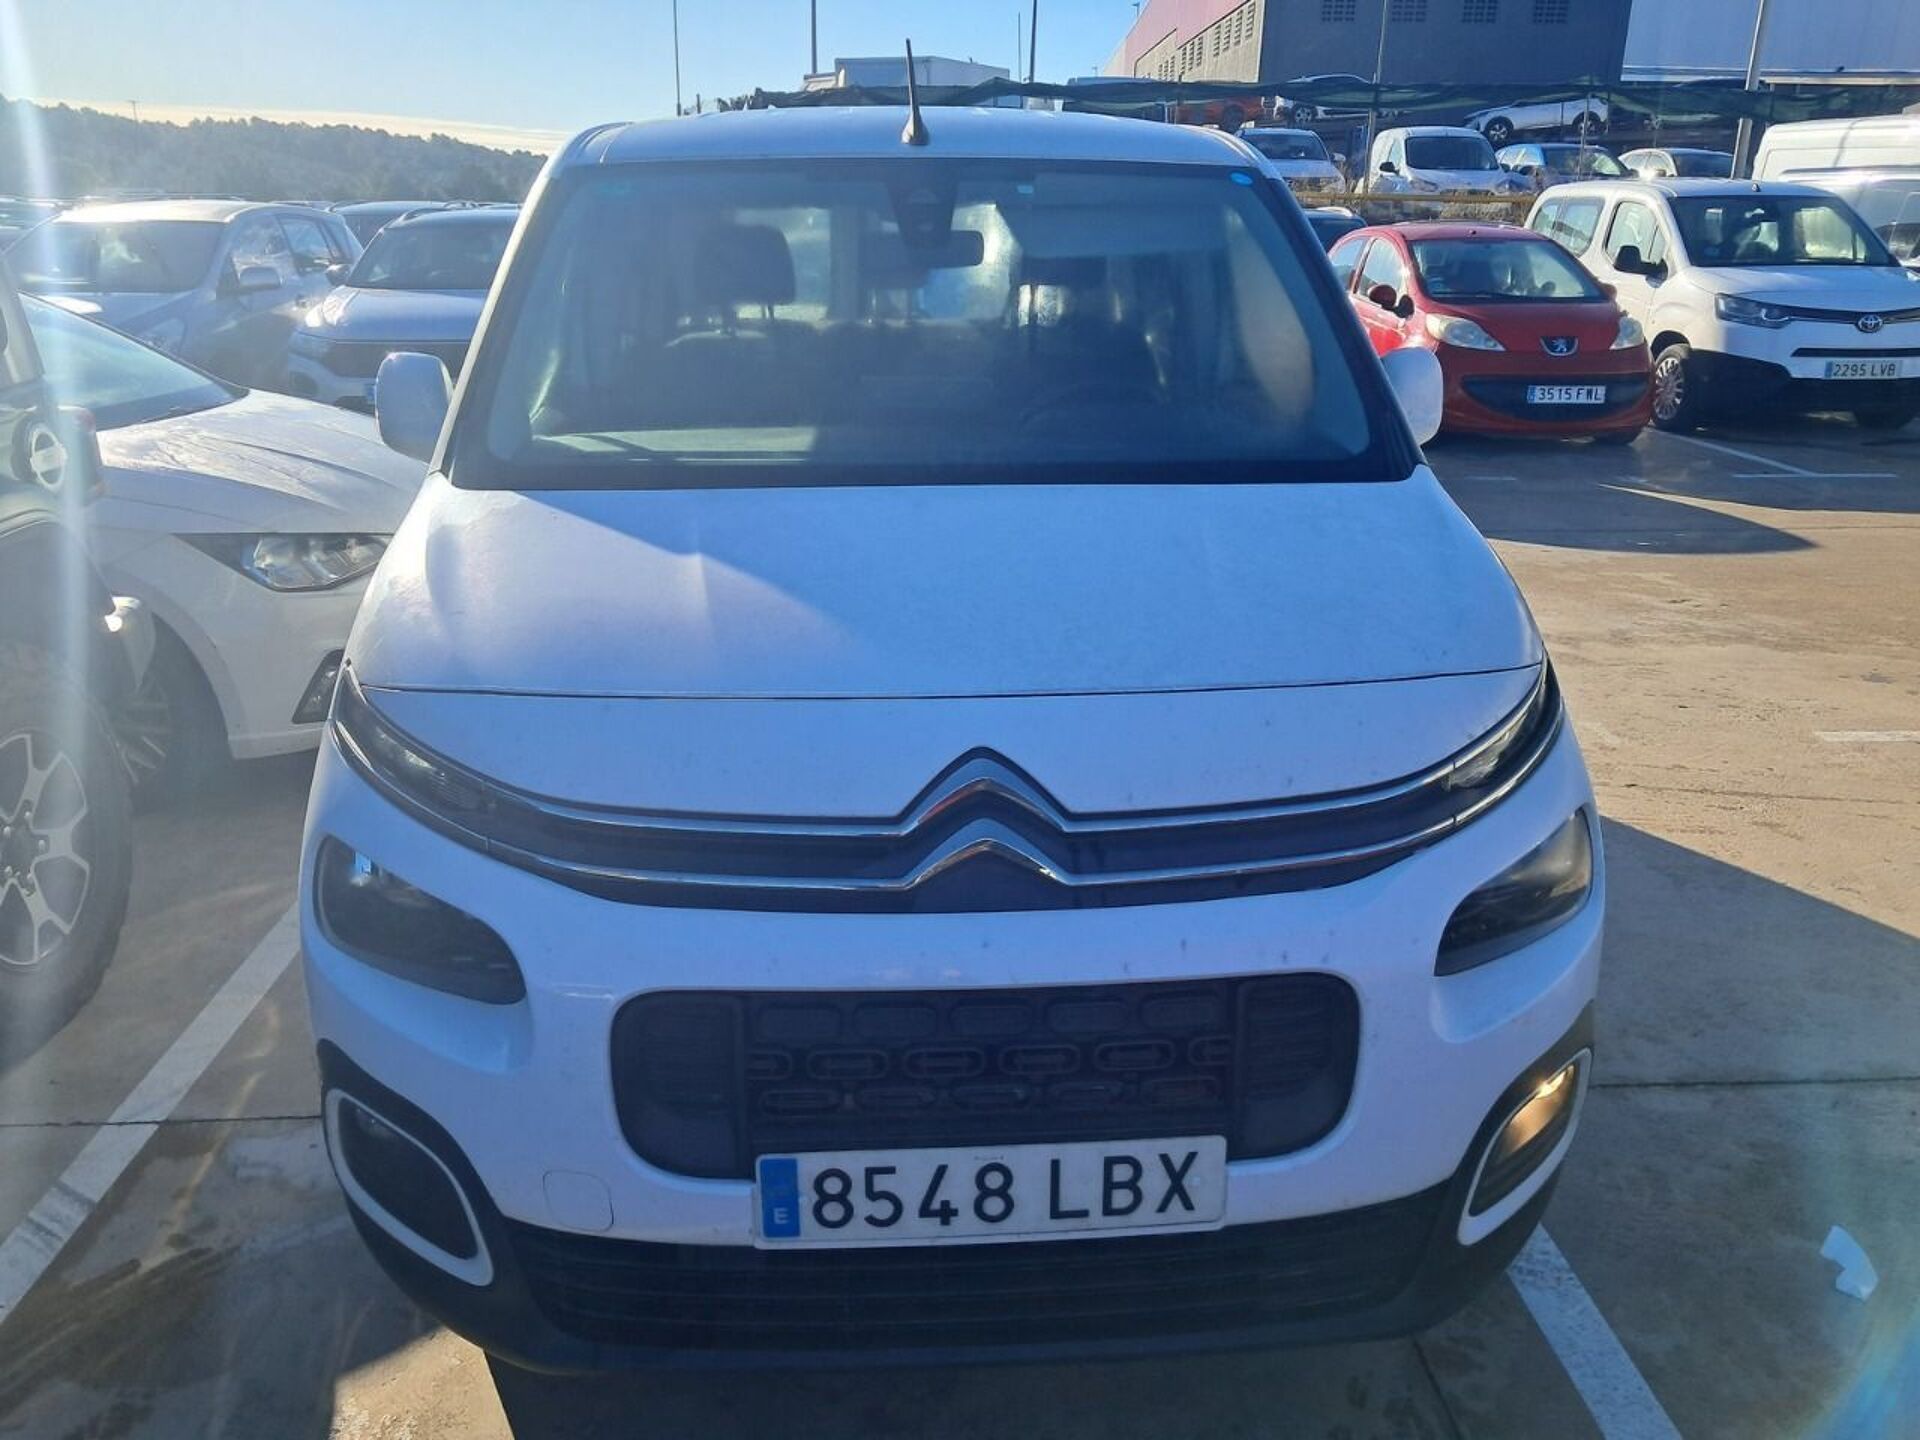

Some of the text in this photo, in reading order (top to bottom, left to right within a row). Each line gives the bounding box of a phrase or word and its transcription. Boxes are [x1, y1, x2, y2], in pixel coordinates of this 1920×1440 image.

[1833, 363, 1897, 377] 2295 LVB
[1538, 387, 1572, 401] 3515
[811, 1151, 1199, 1229] 8548 LBX
[773, 1207, 789, 1224] E
